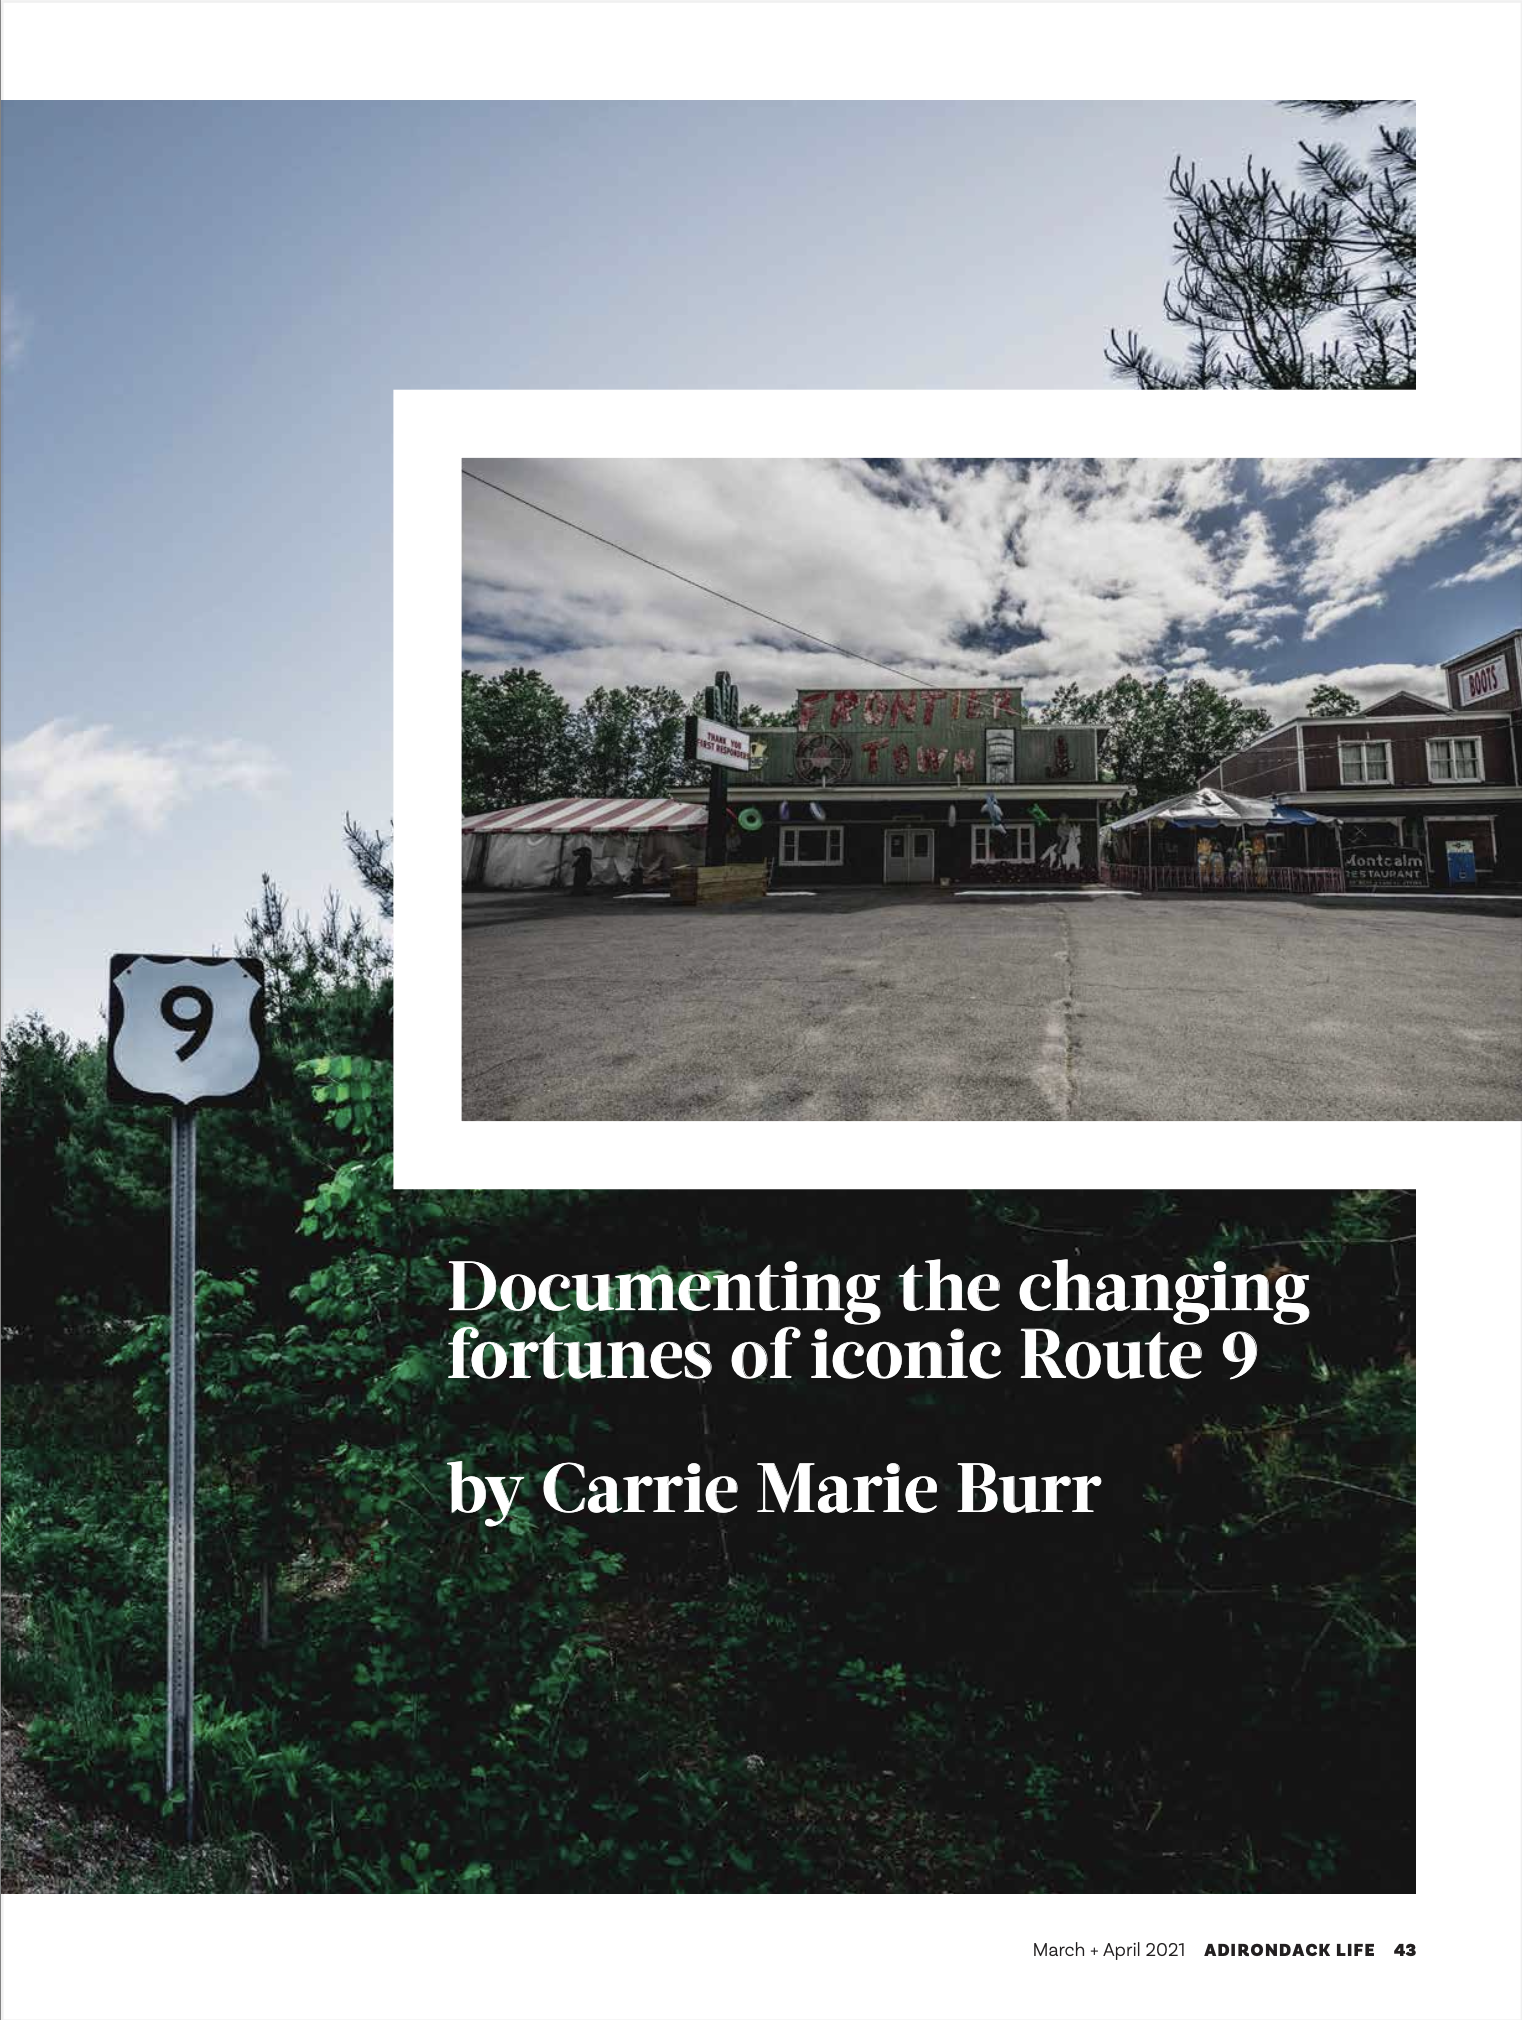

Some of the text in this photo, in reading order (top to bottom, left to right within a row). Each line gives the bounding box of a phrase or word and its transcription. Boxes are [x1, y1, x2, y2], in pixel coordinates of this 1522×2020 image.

[1468, 664, 1498, 697] BOOTS
[798, 690, 1017, 732] FRONTIER
[697, 738, 714, 751] FIRST
[707, 731, 742, 749] THANK YOU
[860, 737, 976, 775] TOWN
[160, 985, 214, 1062] 9
